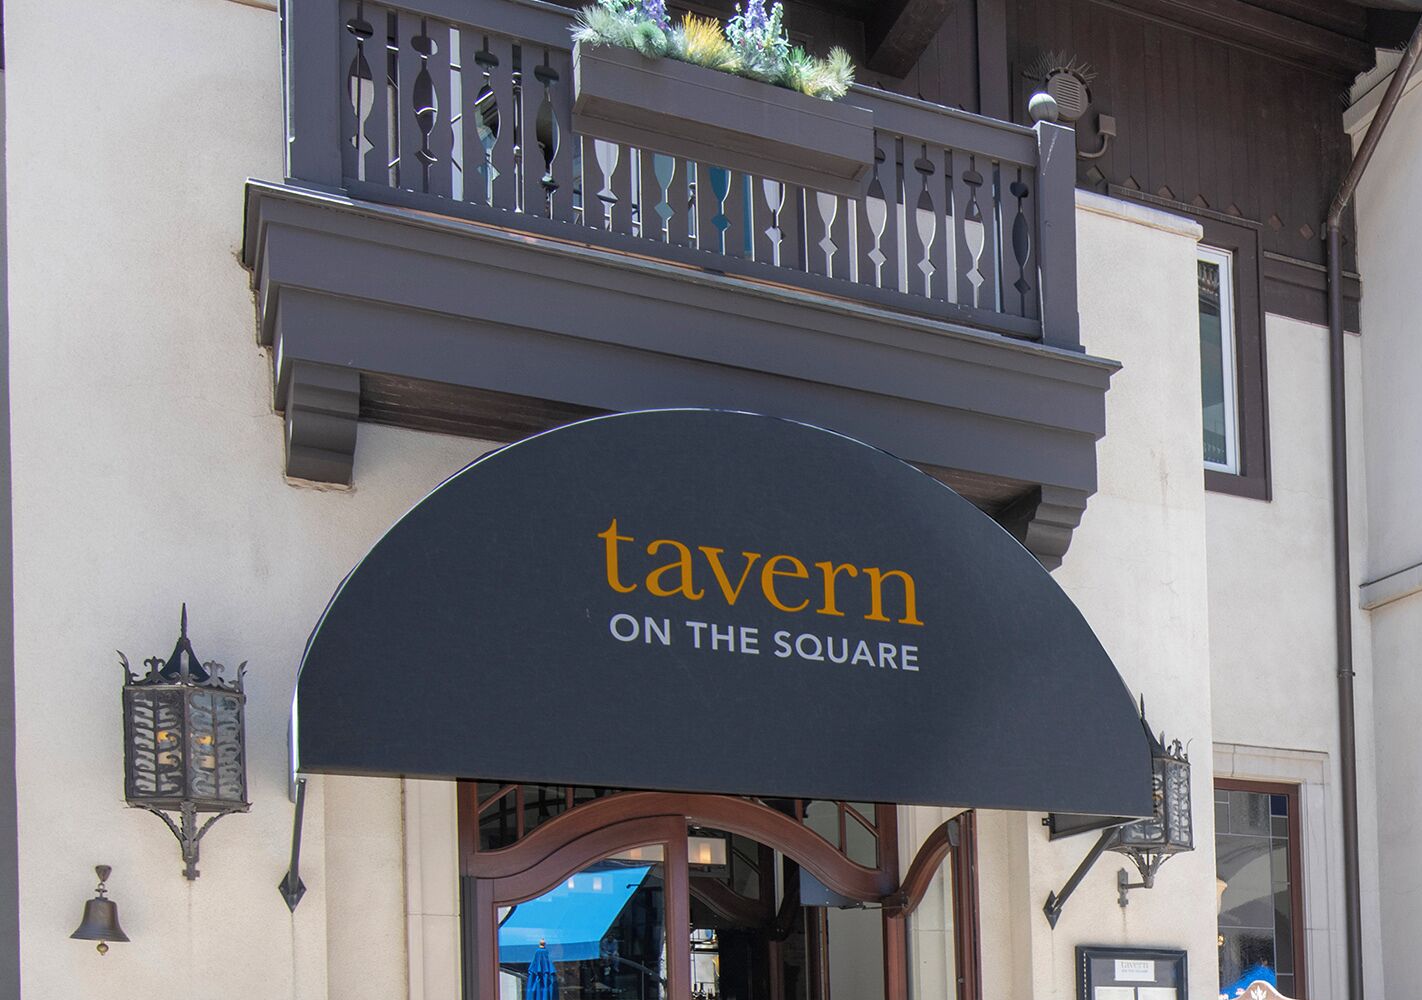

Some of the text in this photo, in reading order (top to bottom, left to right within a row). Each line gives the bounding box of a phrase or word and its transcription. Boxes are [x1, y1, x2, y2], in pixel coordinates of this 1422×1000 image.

[597, 517, 924, 626] tavern
[609, 613, 920, 672] ON THE SQUARE
